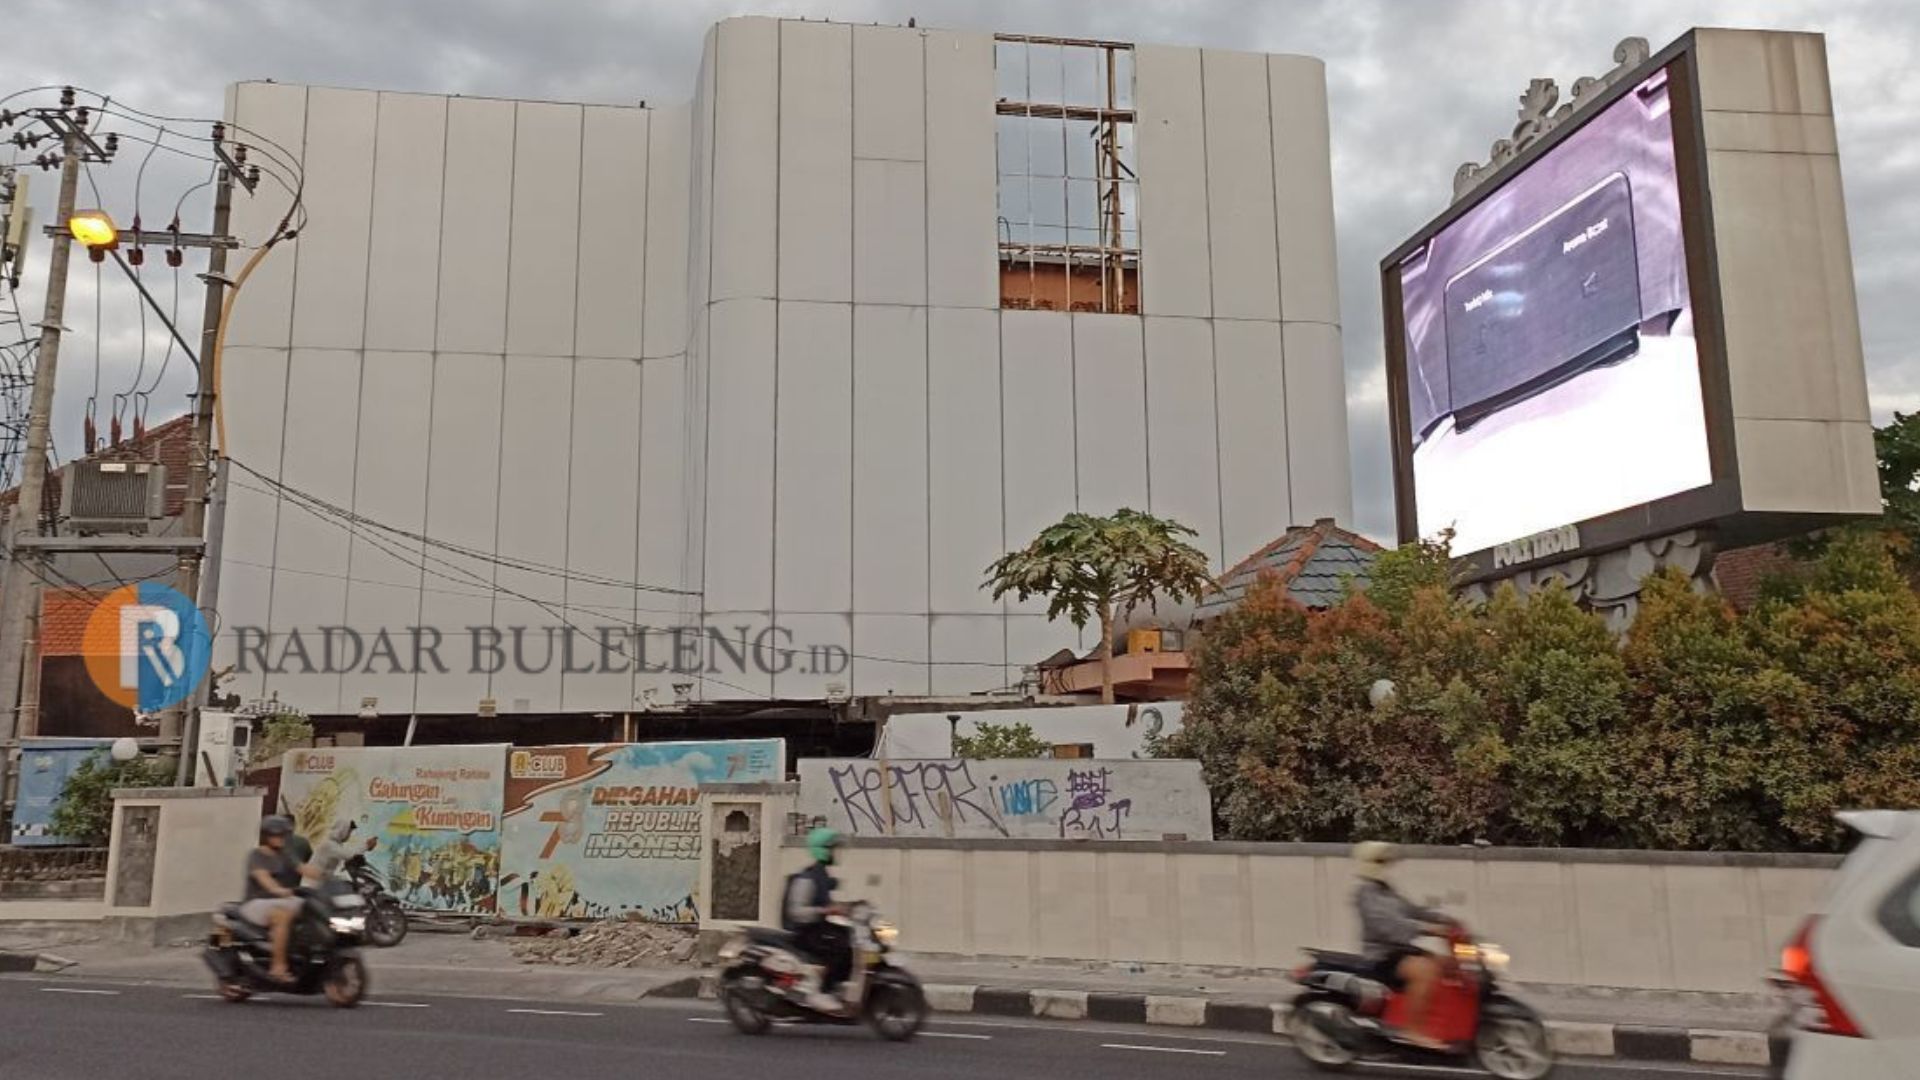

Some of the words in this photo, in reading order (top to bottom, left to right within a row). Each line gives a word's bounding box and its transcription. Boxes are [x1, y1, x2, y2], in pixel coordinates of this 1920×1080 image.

[369, 777, 440, 801] Galungan
[416, 806, 491, 831] Kuningan
[604, 810, 703, 833] REPUBLIK
[584, 833, 702, 860] INDONESI
